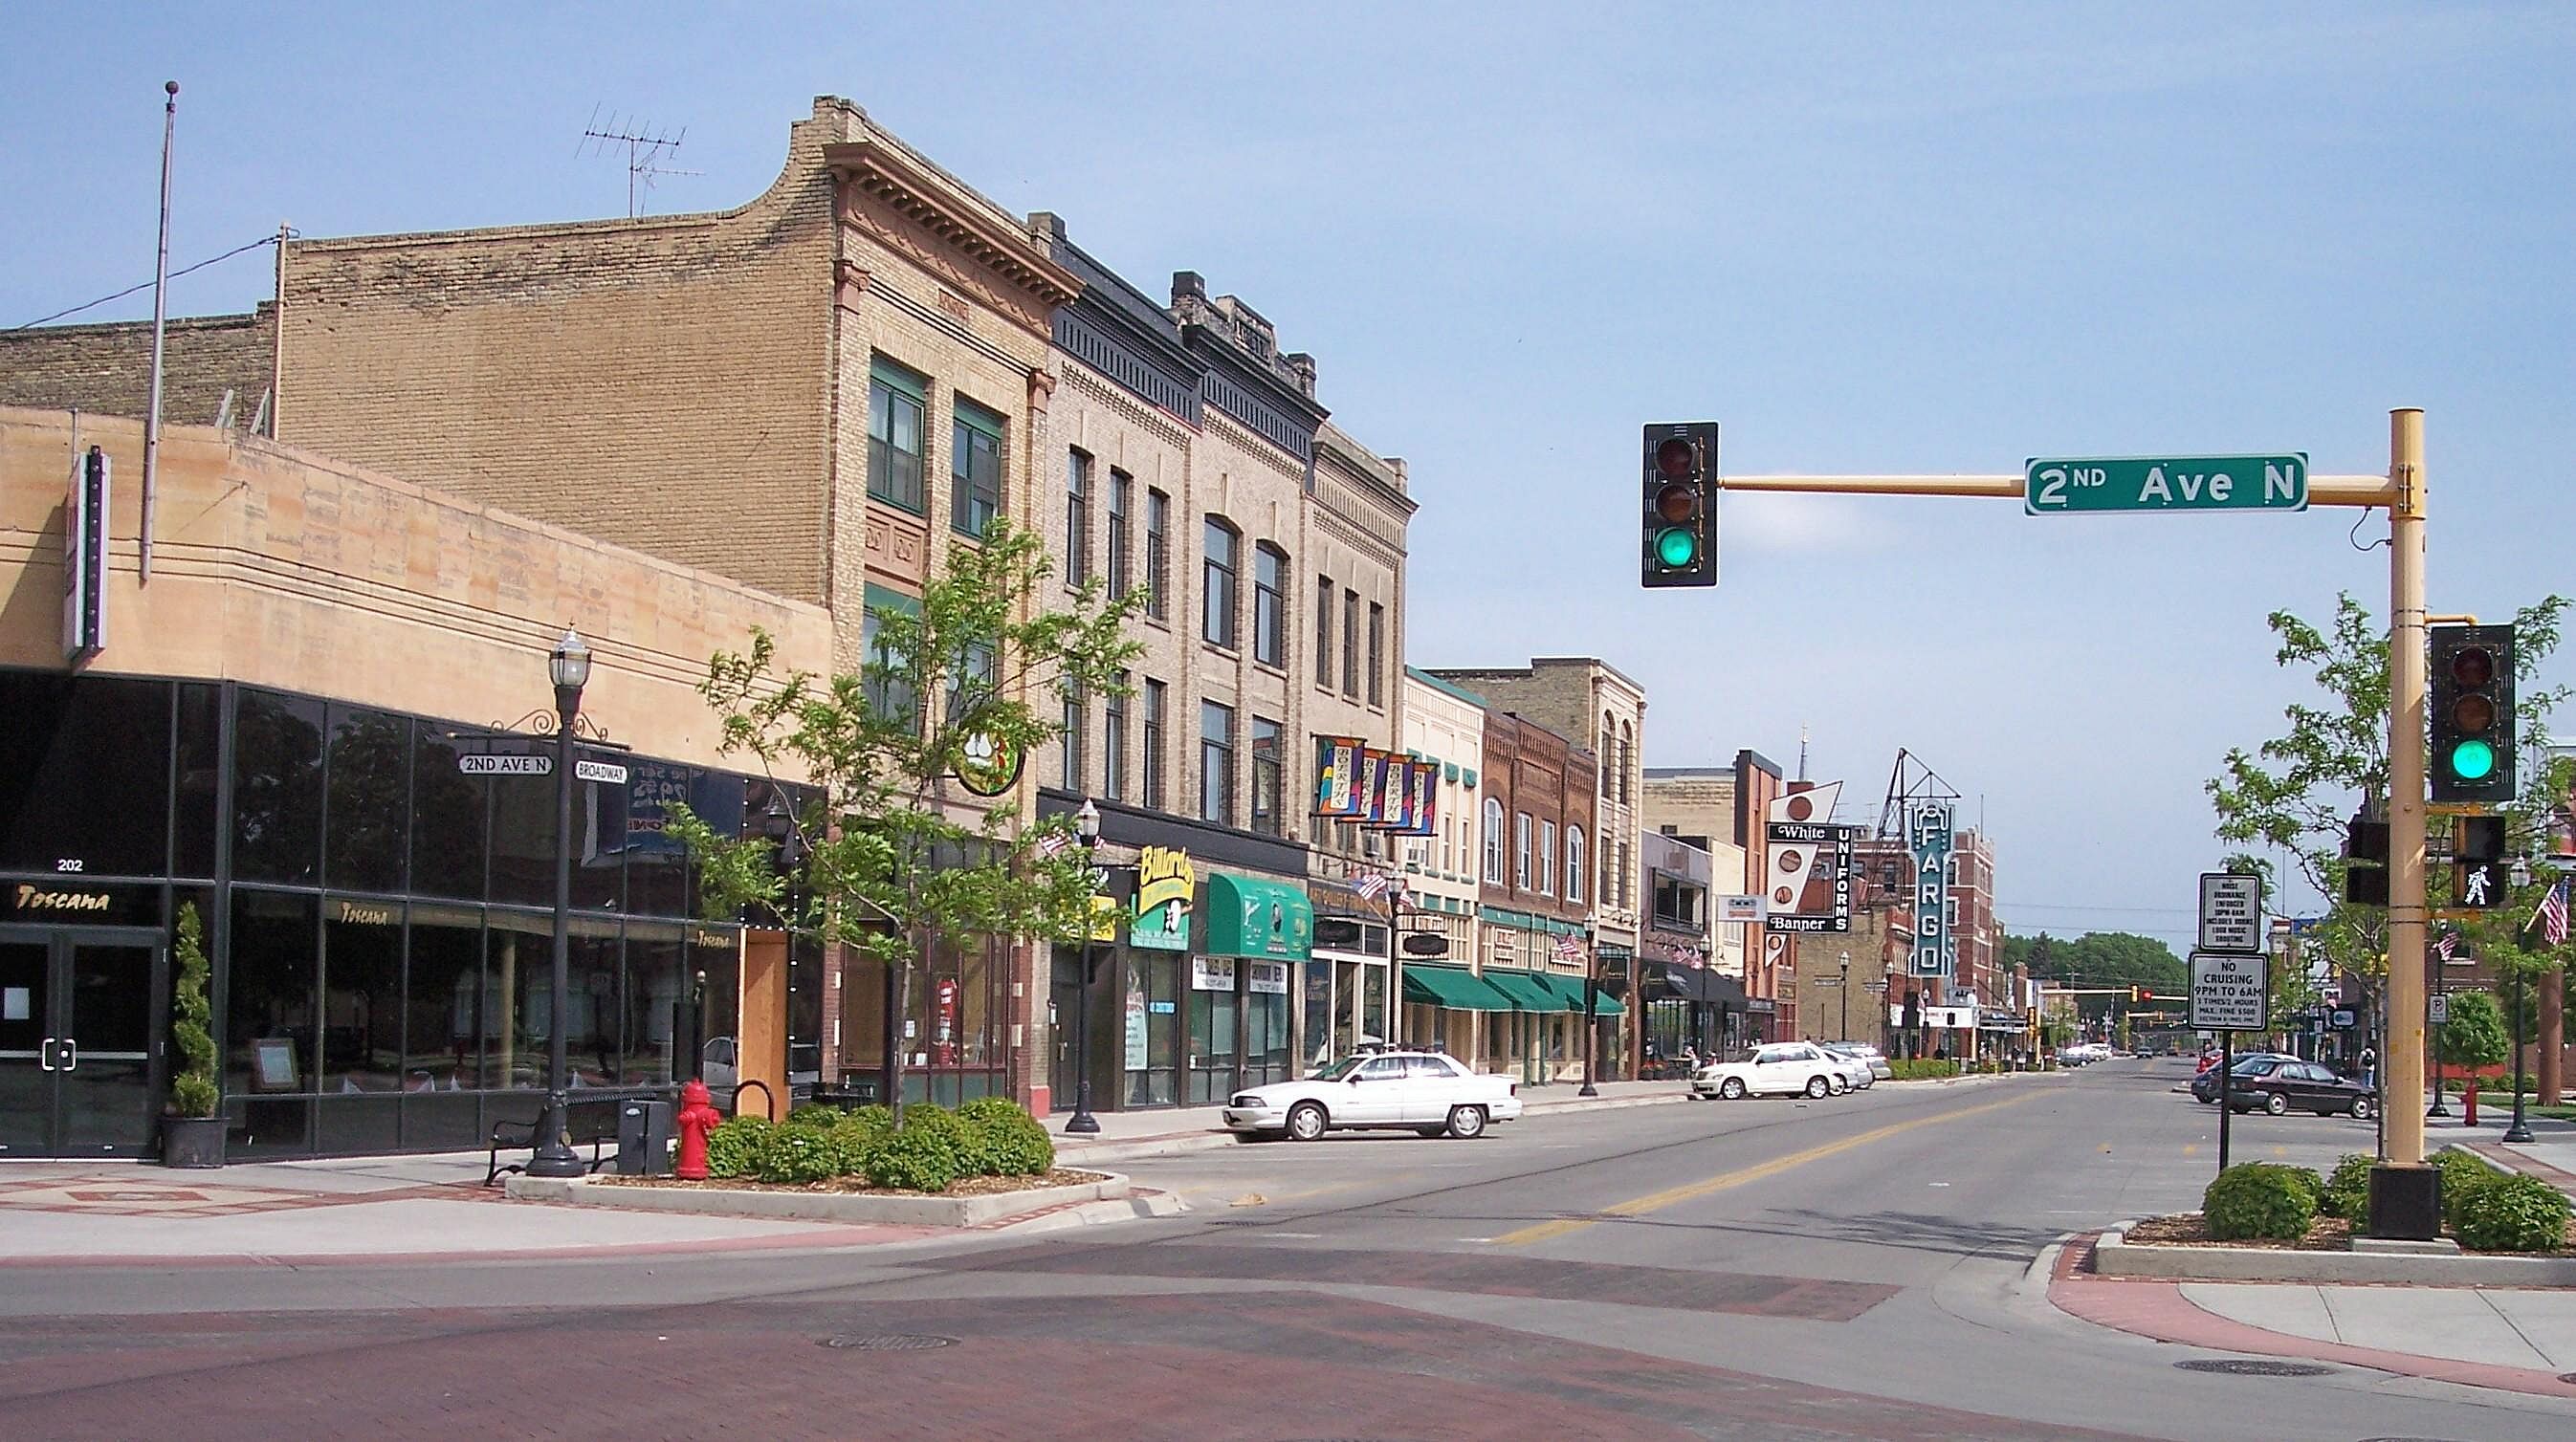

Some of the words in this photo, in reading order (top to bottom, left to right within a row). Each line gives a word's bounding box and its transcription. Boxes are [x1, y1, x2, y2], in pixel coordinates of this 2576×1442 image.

[2037, 469, 2106, 505] 2ND
[2138, 467, 2234, 503] Ave
[2263, 464, 2296, 500] N
[466, 757, 496, 772] 2ND
[500, 757, 530, 772] AVE
[536, 757, 547, 772] N
[578, 763, 625, 781] BROADWAY
[1778, 825, 1826, 841] White
[57, 859, 84, 872] 202
[1140, 845, 1194, 885] Billiards
[1835, 829, 1850, 930] UNIFORMS
[16, 885, 111, 911] Toscana
[1921, 825, 1941, 969] FARGO
[341, 901, 387, 927] Toscana
[1770, 917, 1826, 933] Banner
[2221, 962, 2236, 972] NO
[2203, 973, 2253, 985] CRUISING
[2194, 986, 2217, 995] 9PM
[2220, 986, 2235, 996] TO
[2239, 987, 2262, 996] 6AM
